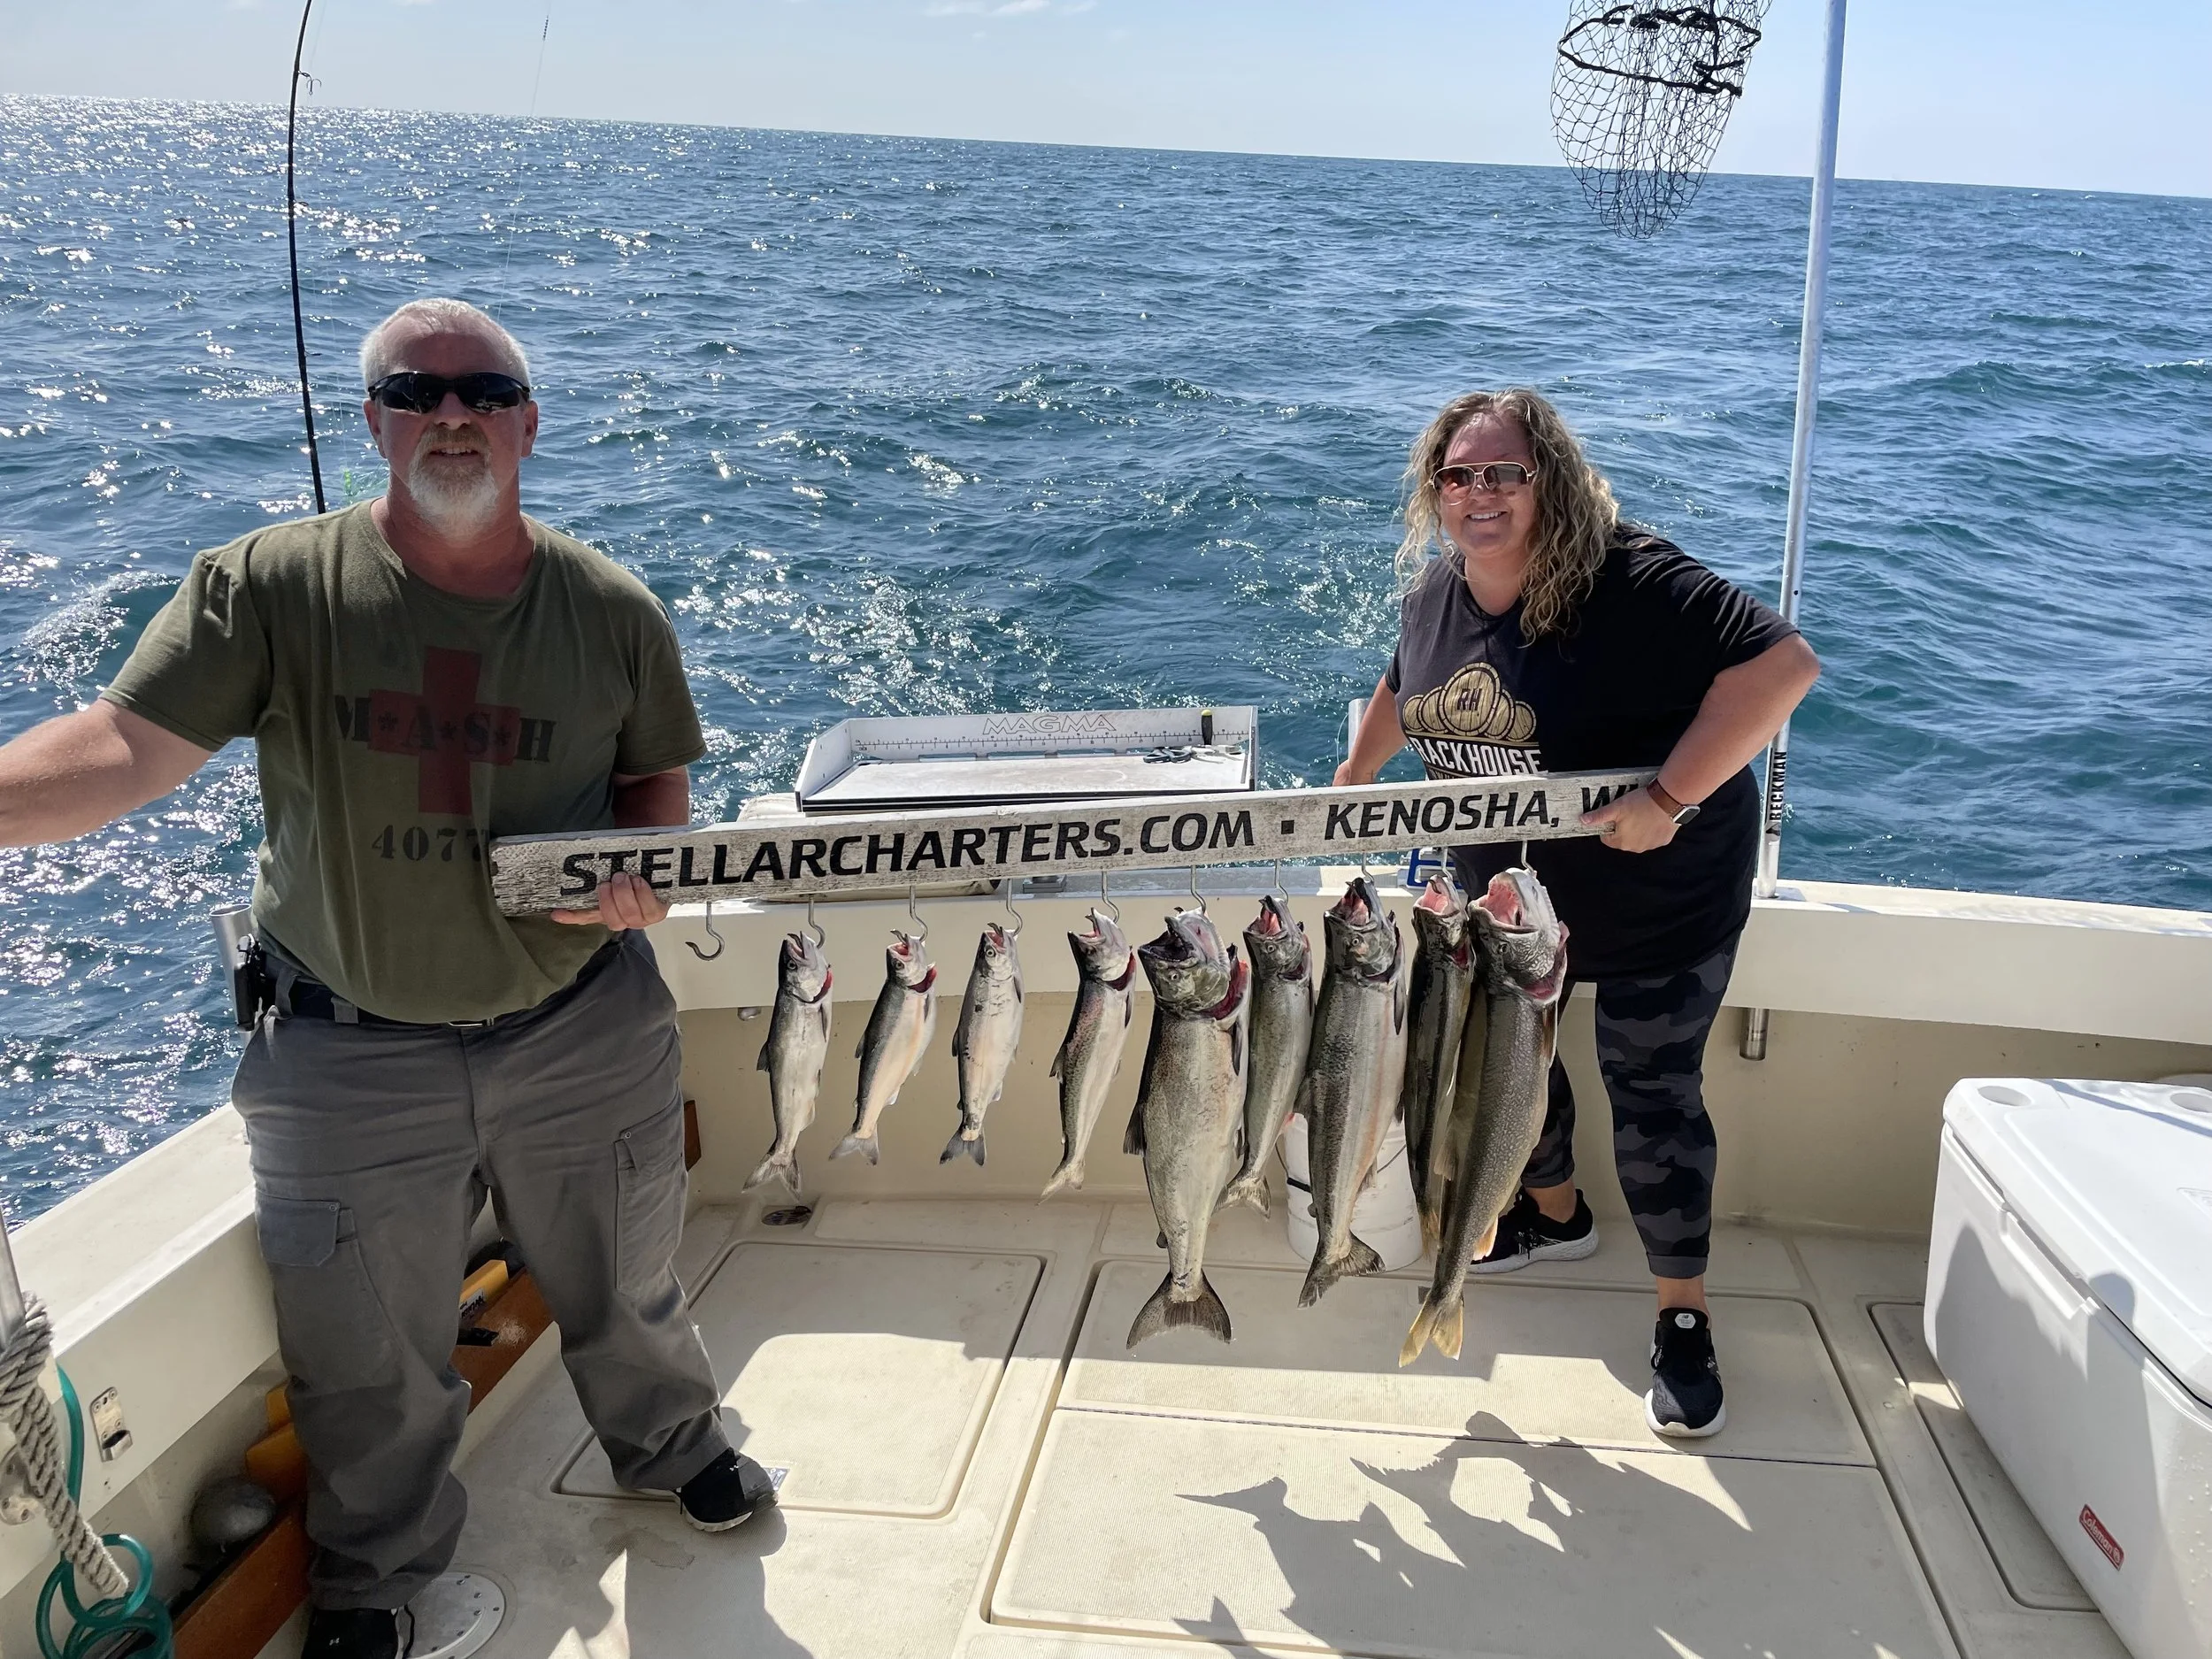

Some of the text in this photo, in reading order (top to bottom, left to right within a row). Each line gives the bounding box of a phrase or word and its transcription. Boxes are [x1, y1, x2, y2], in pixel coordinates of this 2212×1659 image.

[982, 714, 1118, 735] MAGMA
[1409, 736, 1548, 776] RACKHOUSE
[1769, 751, 1787, 821] BECKMAN
[560, 810, 1256, 897] STELLARCHARTERS.COM
[1325, 790, 1560, 841] KENOSHA,
[2083, 1509, 2115, 1555] Coleman
